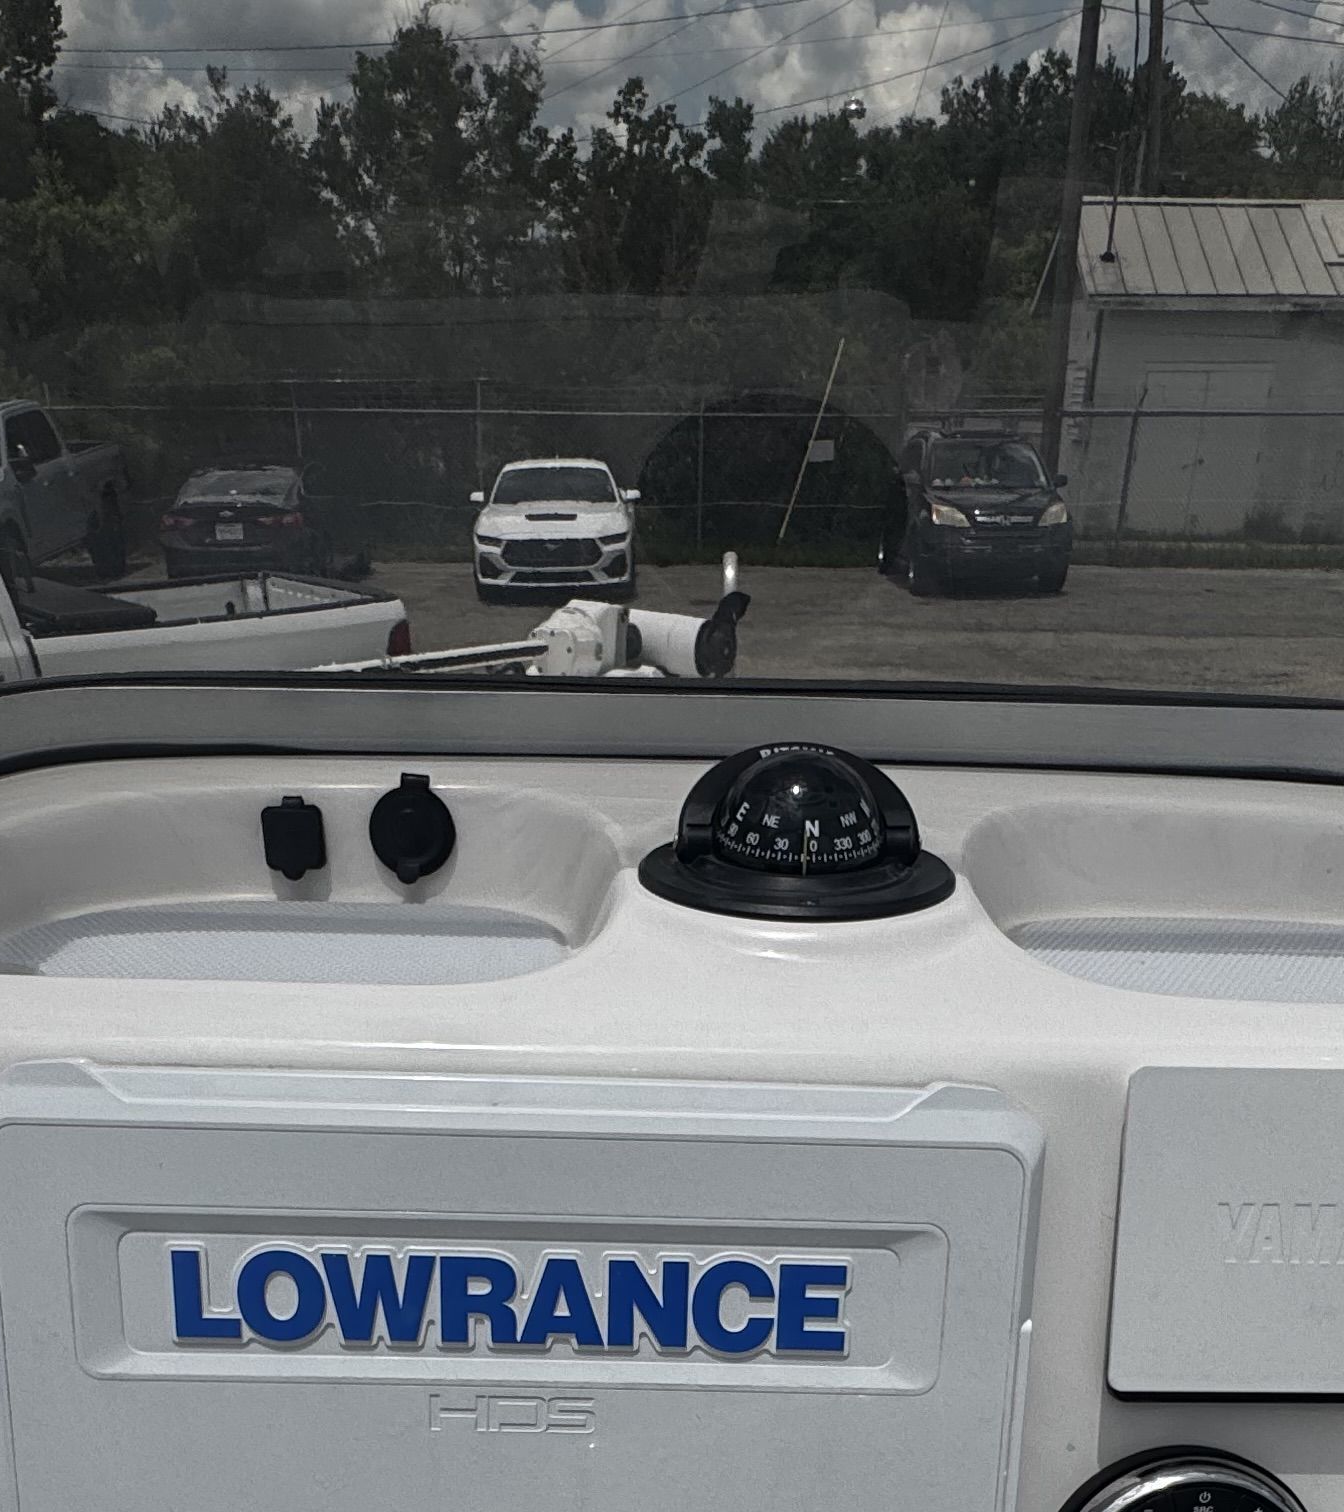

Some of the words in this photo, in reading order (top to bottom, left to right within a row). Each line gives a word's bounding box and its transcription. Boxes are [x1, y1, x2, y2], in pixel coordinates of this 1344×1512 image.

[736, 801, 750, 822] E
[762, 813, 781, 829] NE
[805, 819, 820, 838] N
[839, 810, 857, 828] NW
[746, 831, 760, 846] 60
[773, 837, 789, 851] 30
[809, 840, 818, 852] 0
[833, 836, 853, 851] 330
[857, 828, 871, 846] 300
[166, 1246, 850, 1358] LOWRANCE
[427, 1392, 597, 1435] HDS
